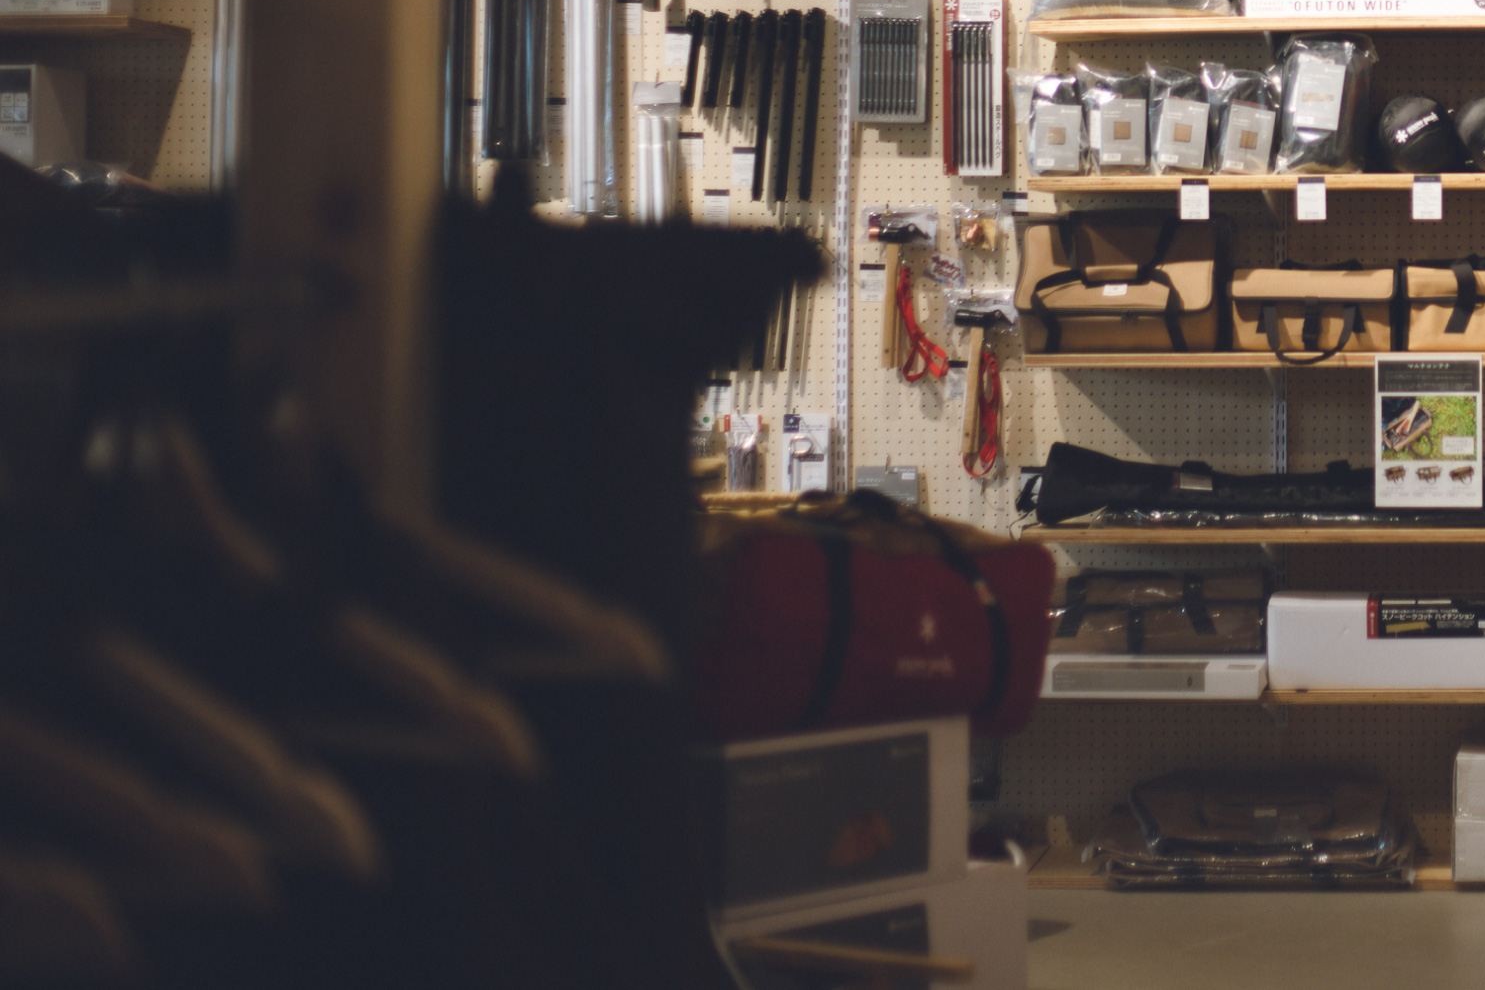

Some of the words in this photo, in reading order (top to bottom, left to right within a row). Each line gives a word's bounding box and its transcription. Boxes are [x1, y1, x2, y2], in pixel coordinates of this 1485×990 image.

[1288, 0, 1356, 12] "OFUTON
[1364, 0, 1408, 12] WIDE"
[1407, 362, 1450, 370] マルチコンテナ
[1381, 613, 1433, 621] スノーピークコット
[1434, 612, 1475, 621] ハイテンション
